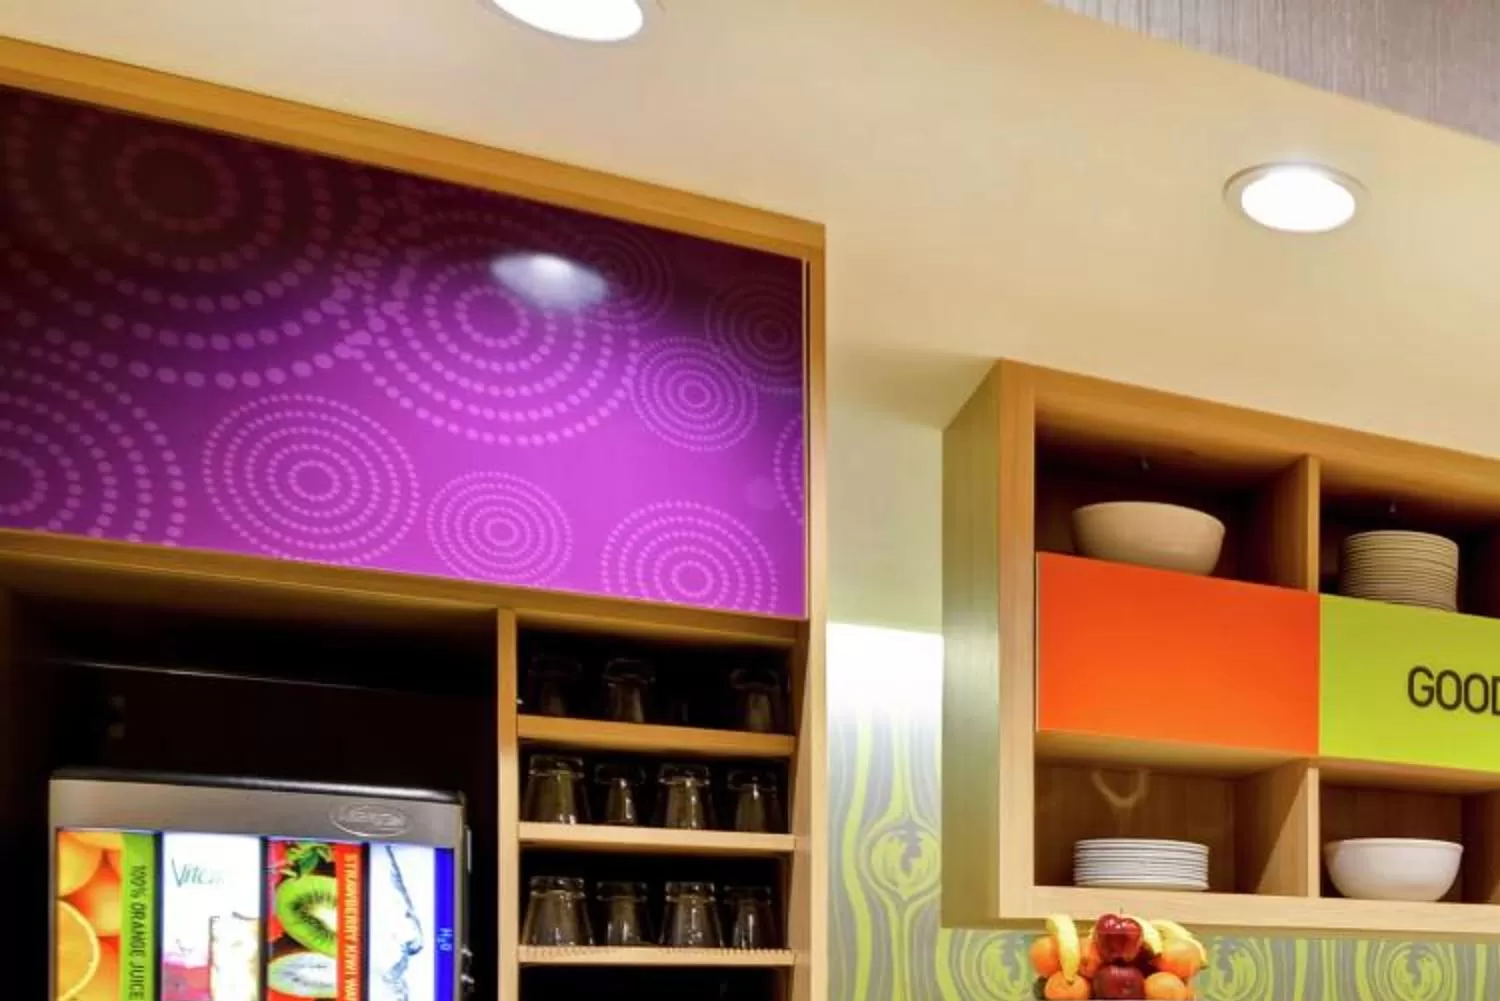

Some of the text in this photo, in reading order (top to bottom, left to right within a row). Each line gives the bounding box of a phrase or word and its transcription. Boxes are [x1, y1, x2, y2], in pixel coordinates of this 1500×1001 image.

[129, 865, 147, 1001] 100% ORANGE JUICE
[344, 853, 358, 940] STRAWBERRY
[344, 943, 358, 977] KIWI
